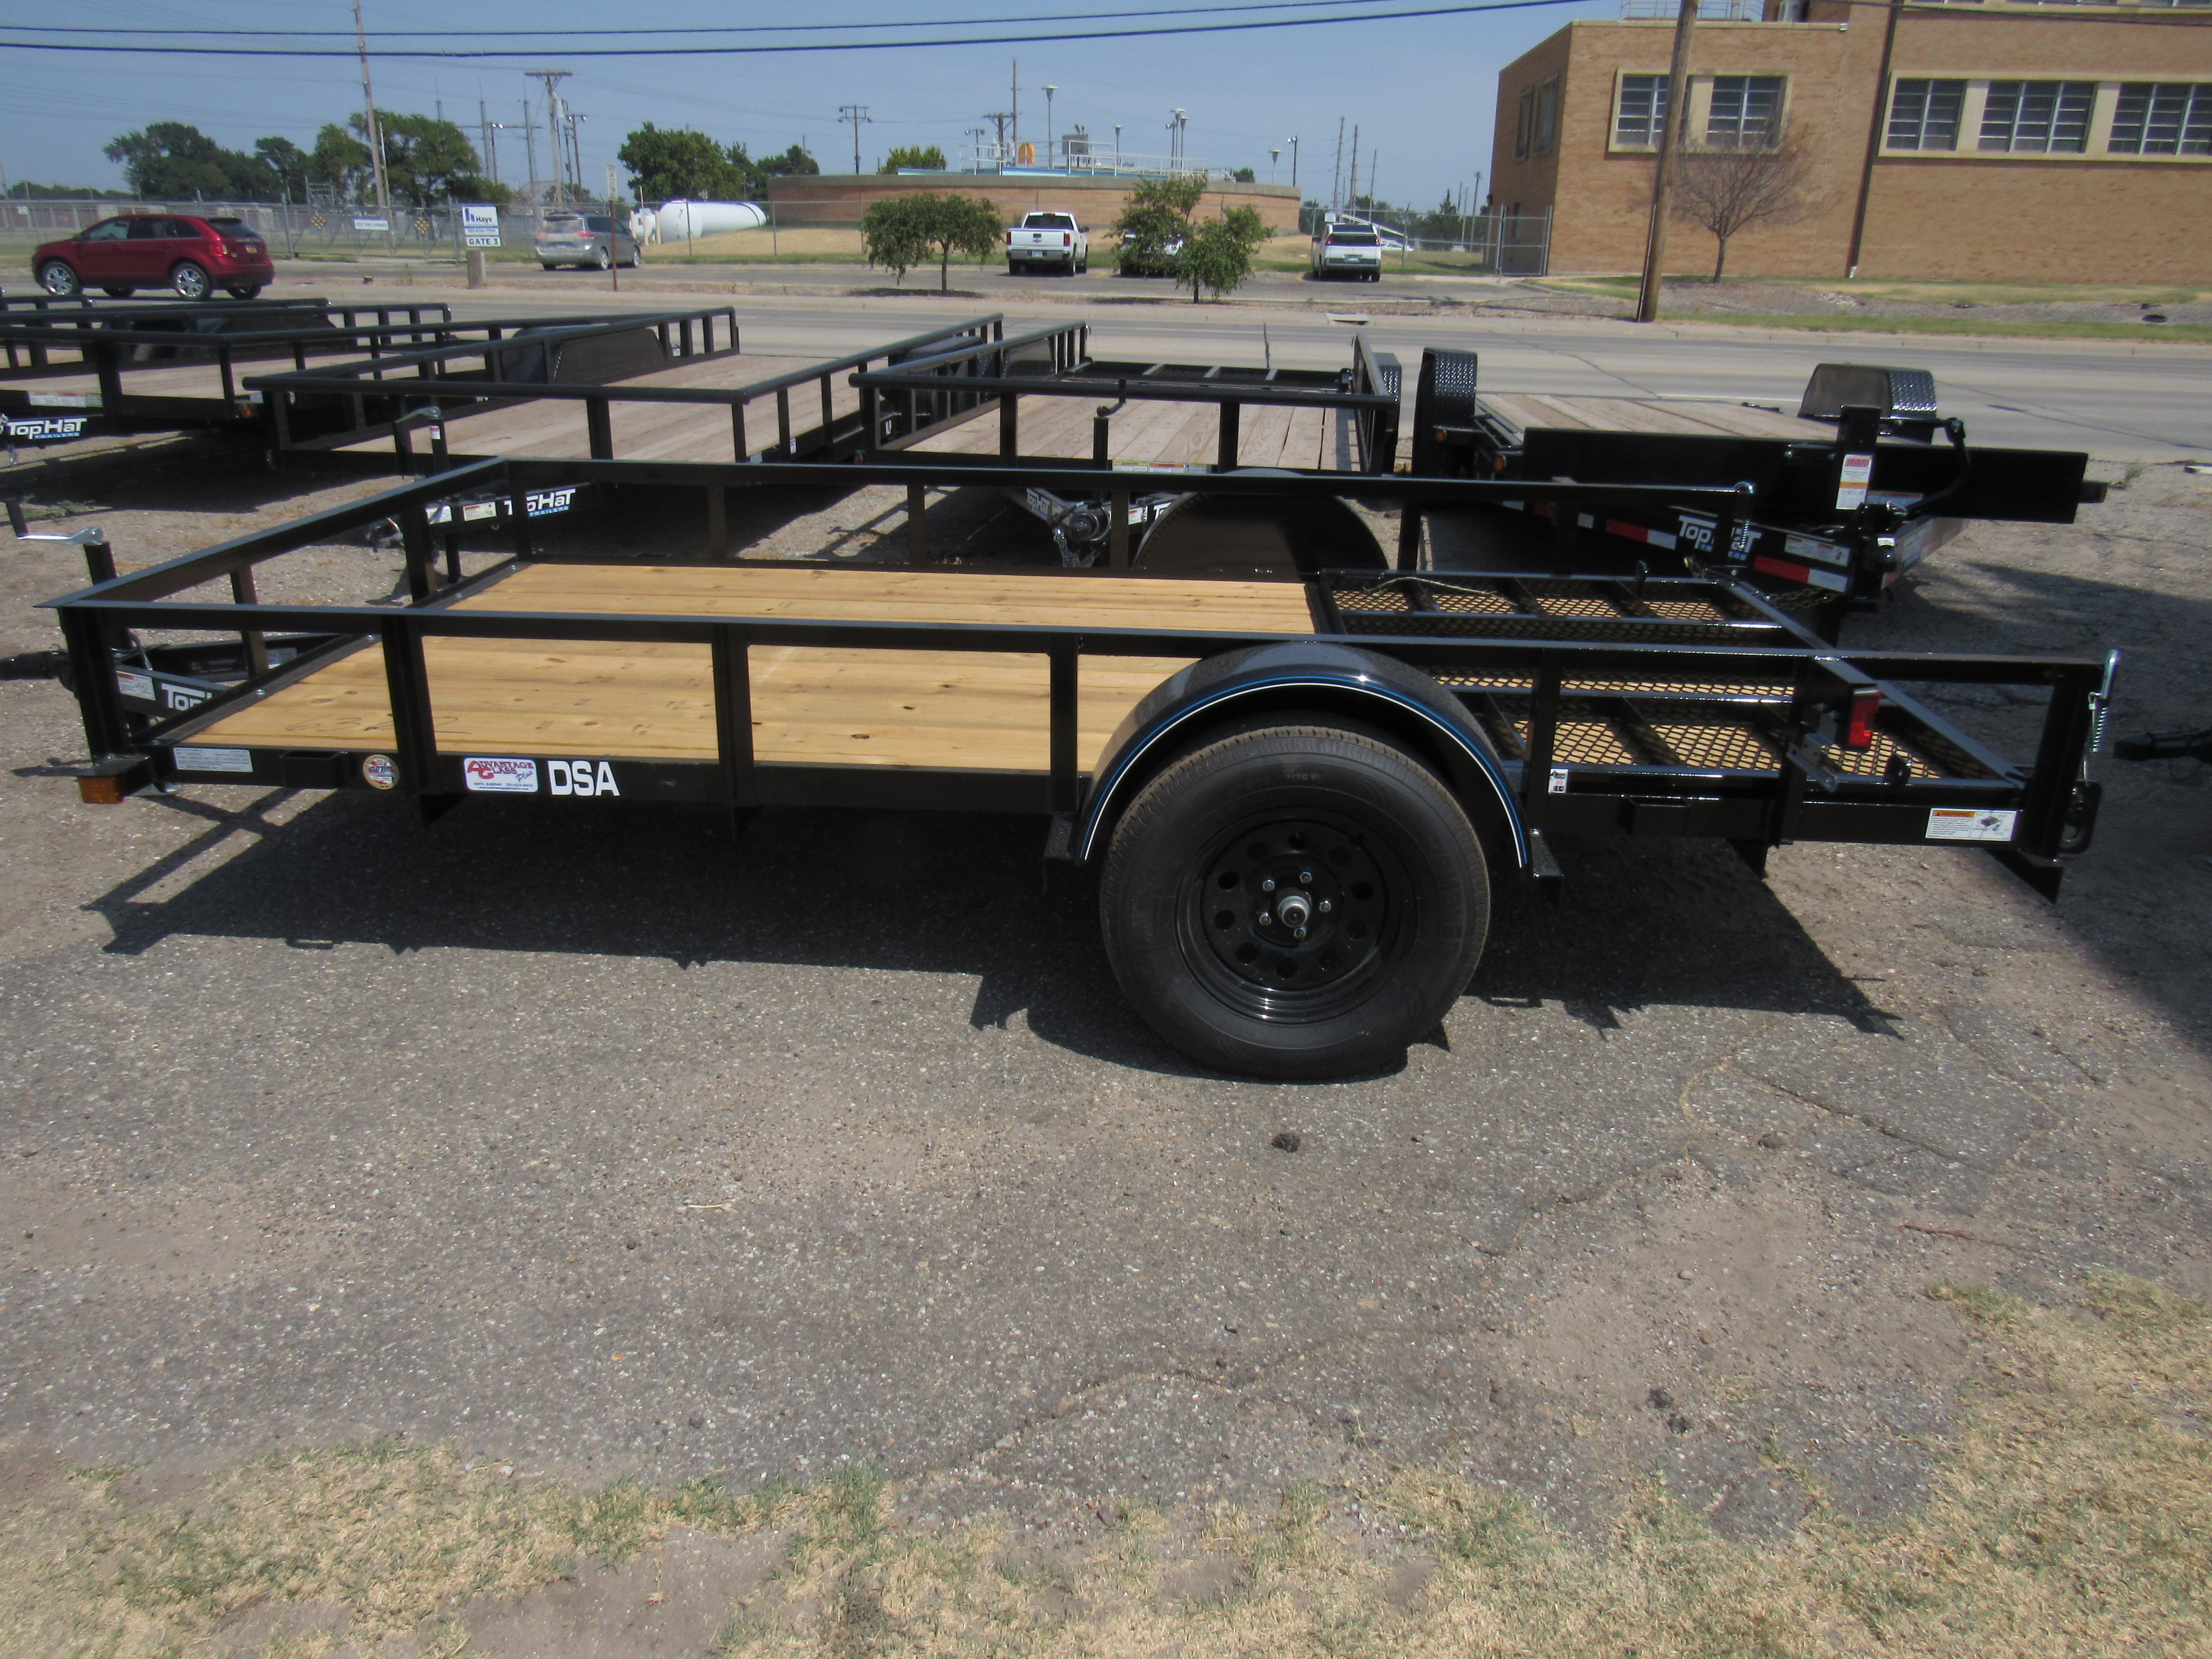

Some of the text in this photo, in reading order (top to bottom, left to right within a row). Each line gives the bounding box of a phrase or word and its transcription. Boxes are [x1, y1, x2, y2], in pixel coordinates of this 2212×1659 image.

[467, 760, 534, 773] ADVANTAGE
[516, 770, 533, 783] Plus
[548, 759, 621, 796] DSA
